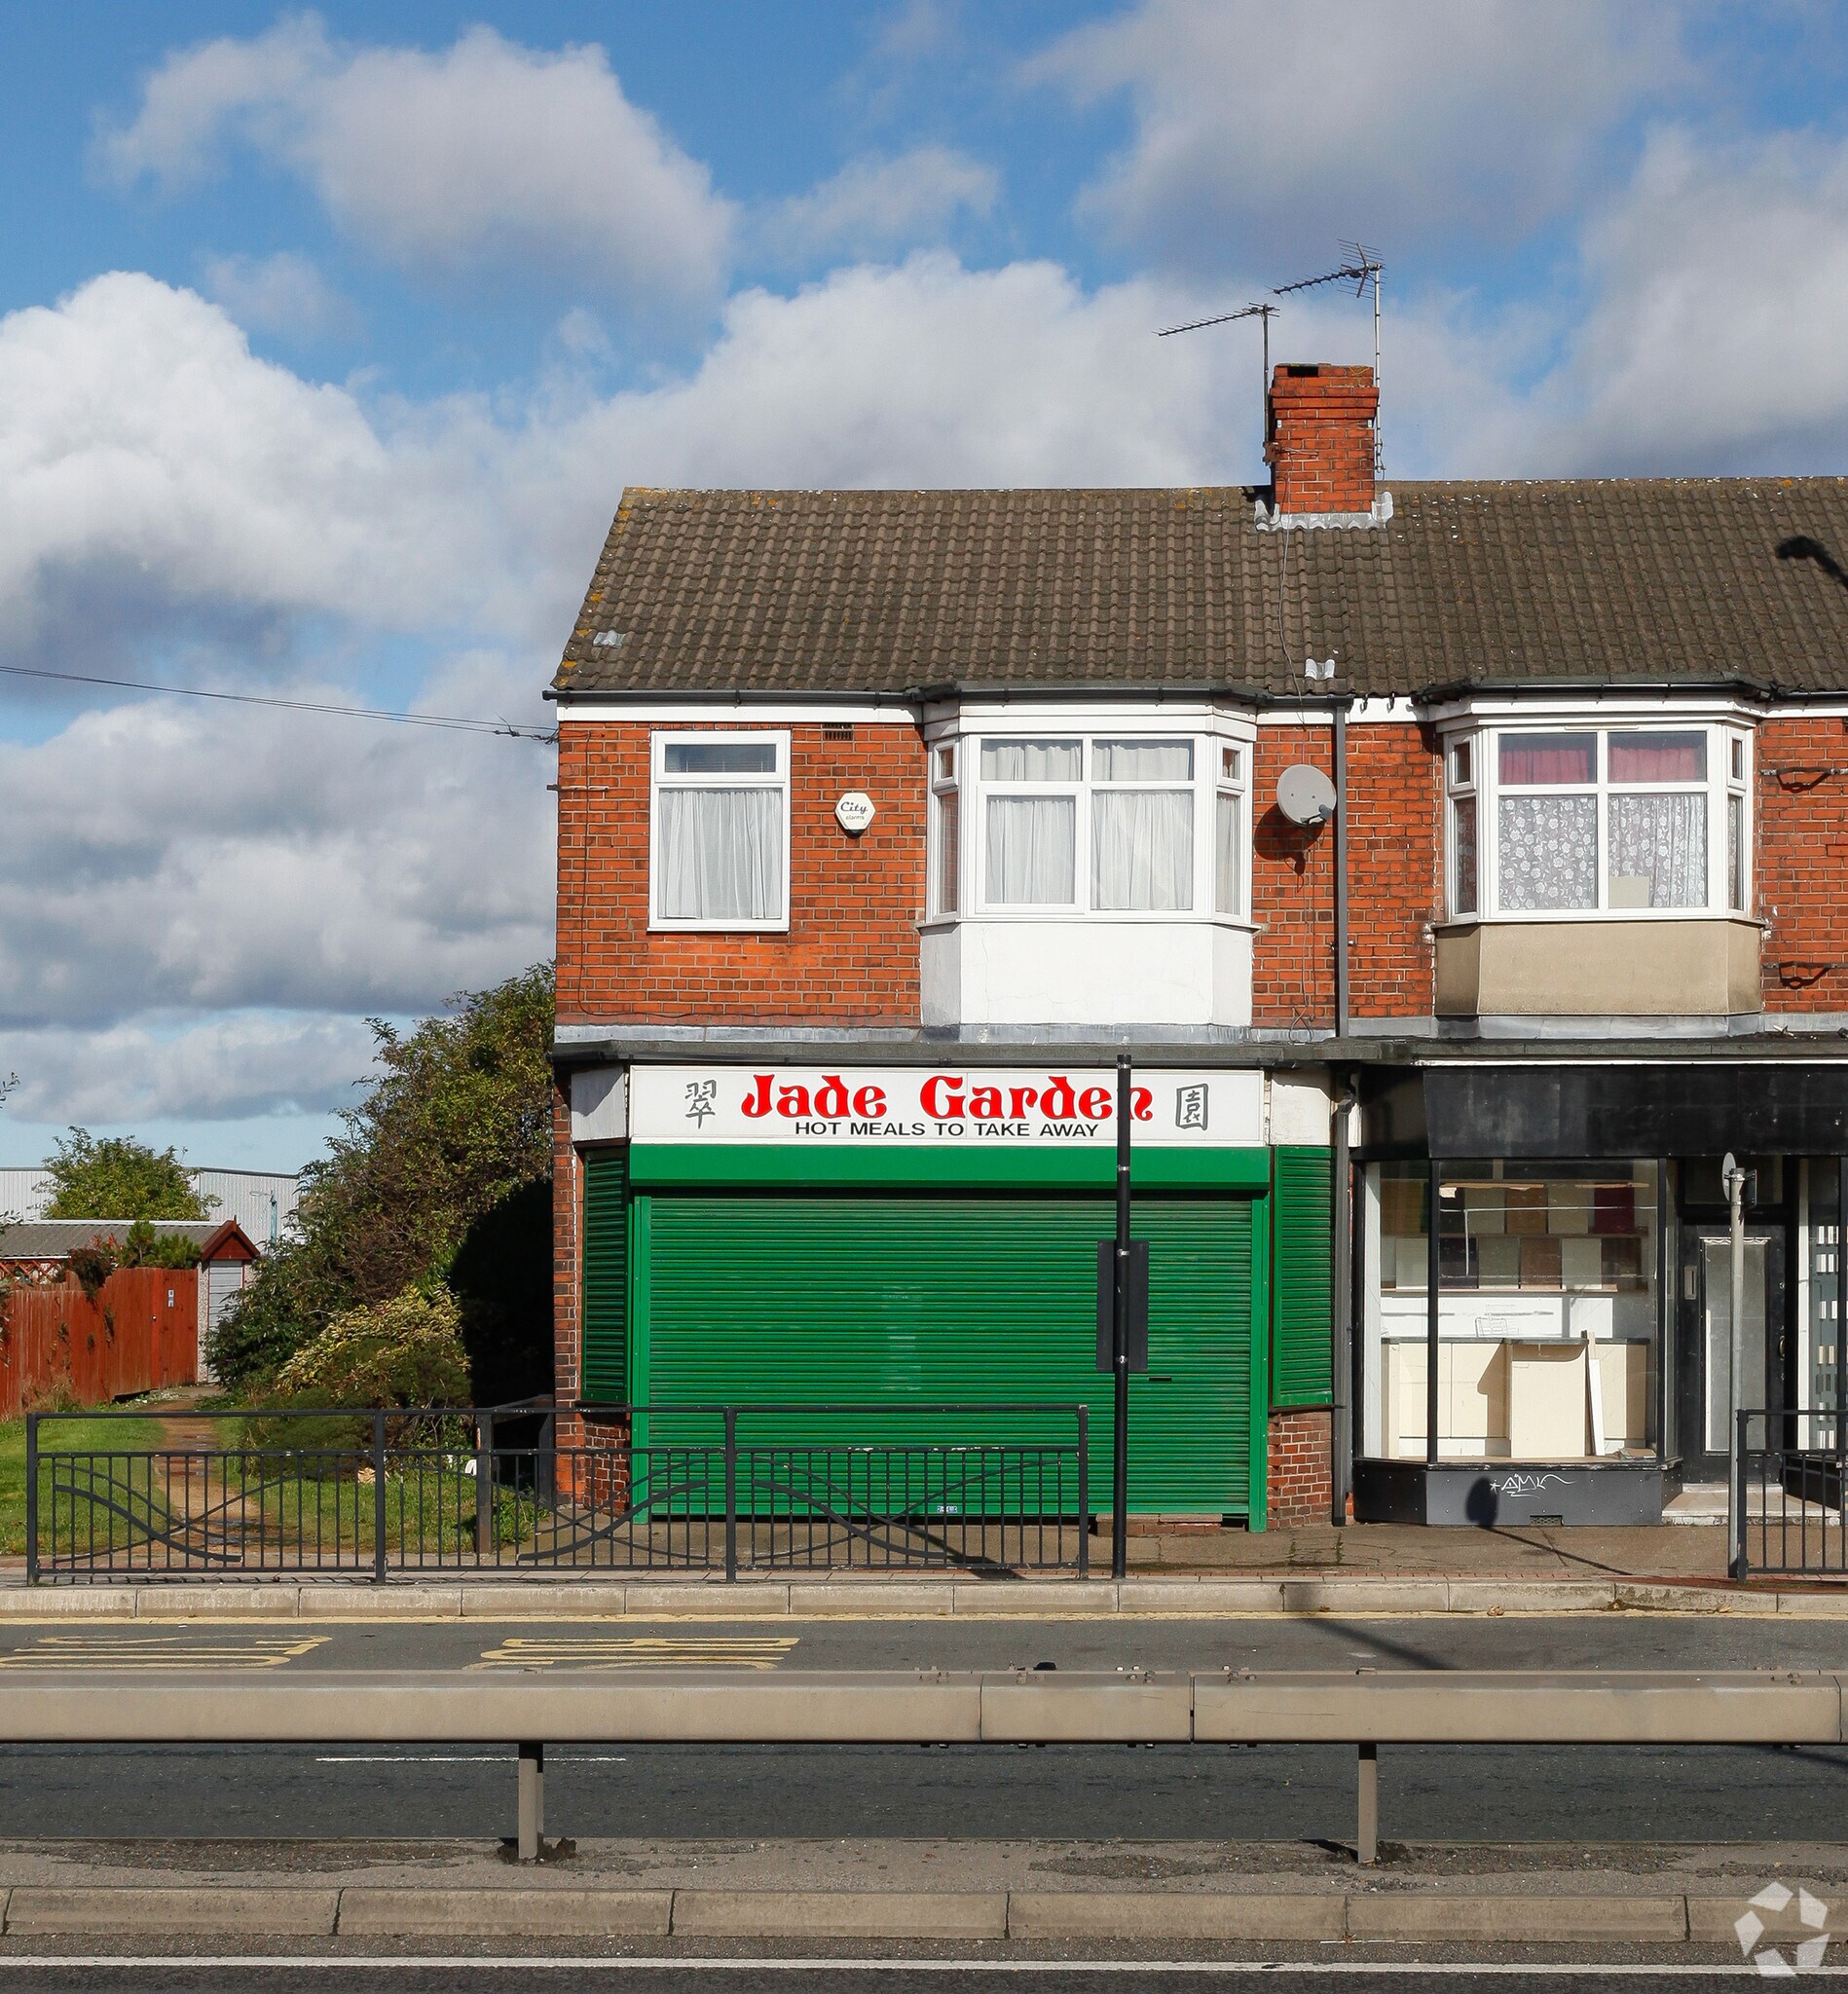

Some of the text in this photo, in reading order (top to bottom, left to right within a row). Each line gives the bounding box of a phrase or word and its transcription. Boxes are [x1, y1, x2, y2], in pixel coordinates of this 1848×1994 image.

[840, 801, 868, 814] City
[684, 1079, 717, 1129] 翠
[741, 1074, 1154, 1120] Jade Garden
[1175, 1083, 1209, 1132] 園
[794, 1122, 1099, 1136] HOT MEALS TO TAKE AWAY
